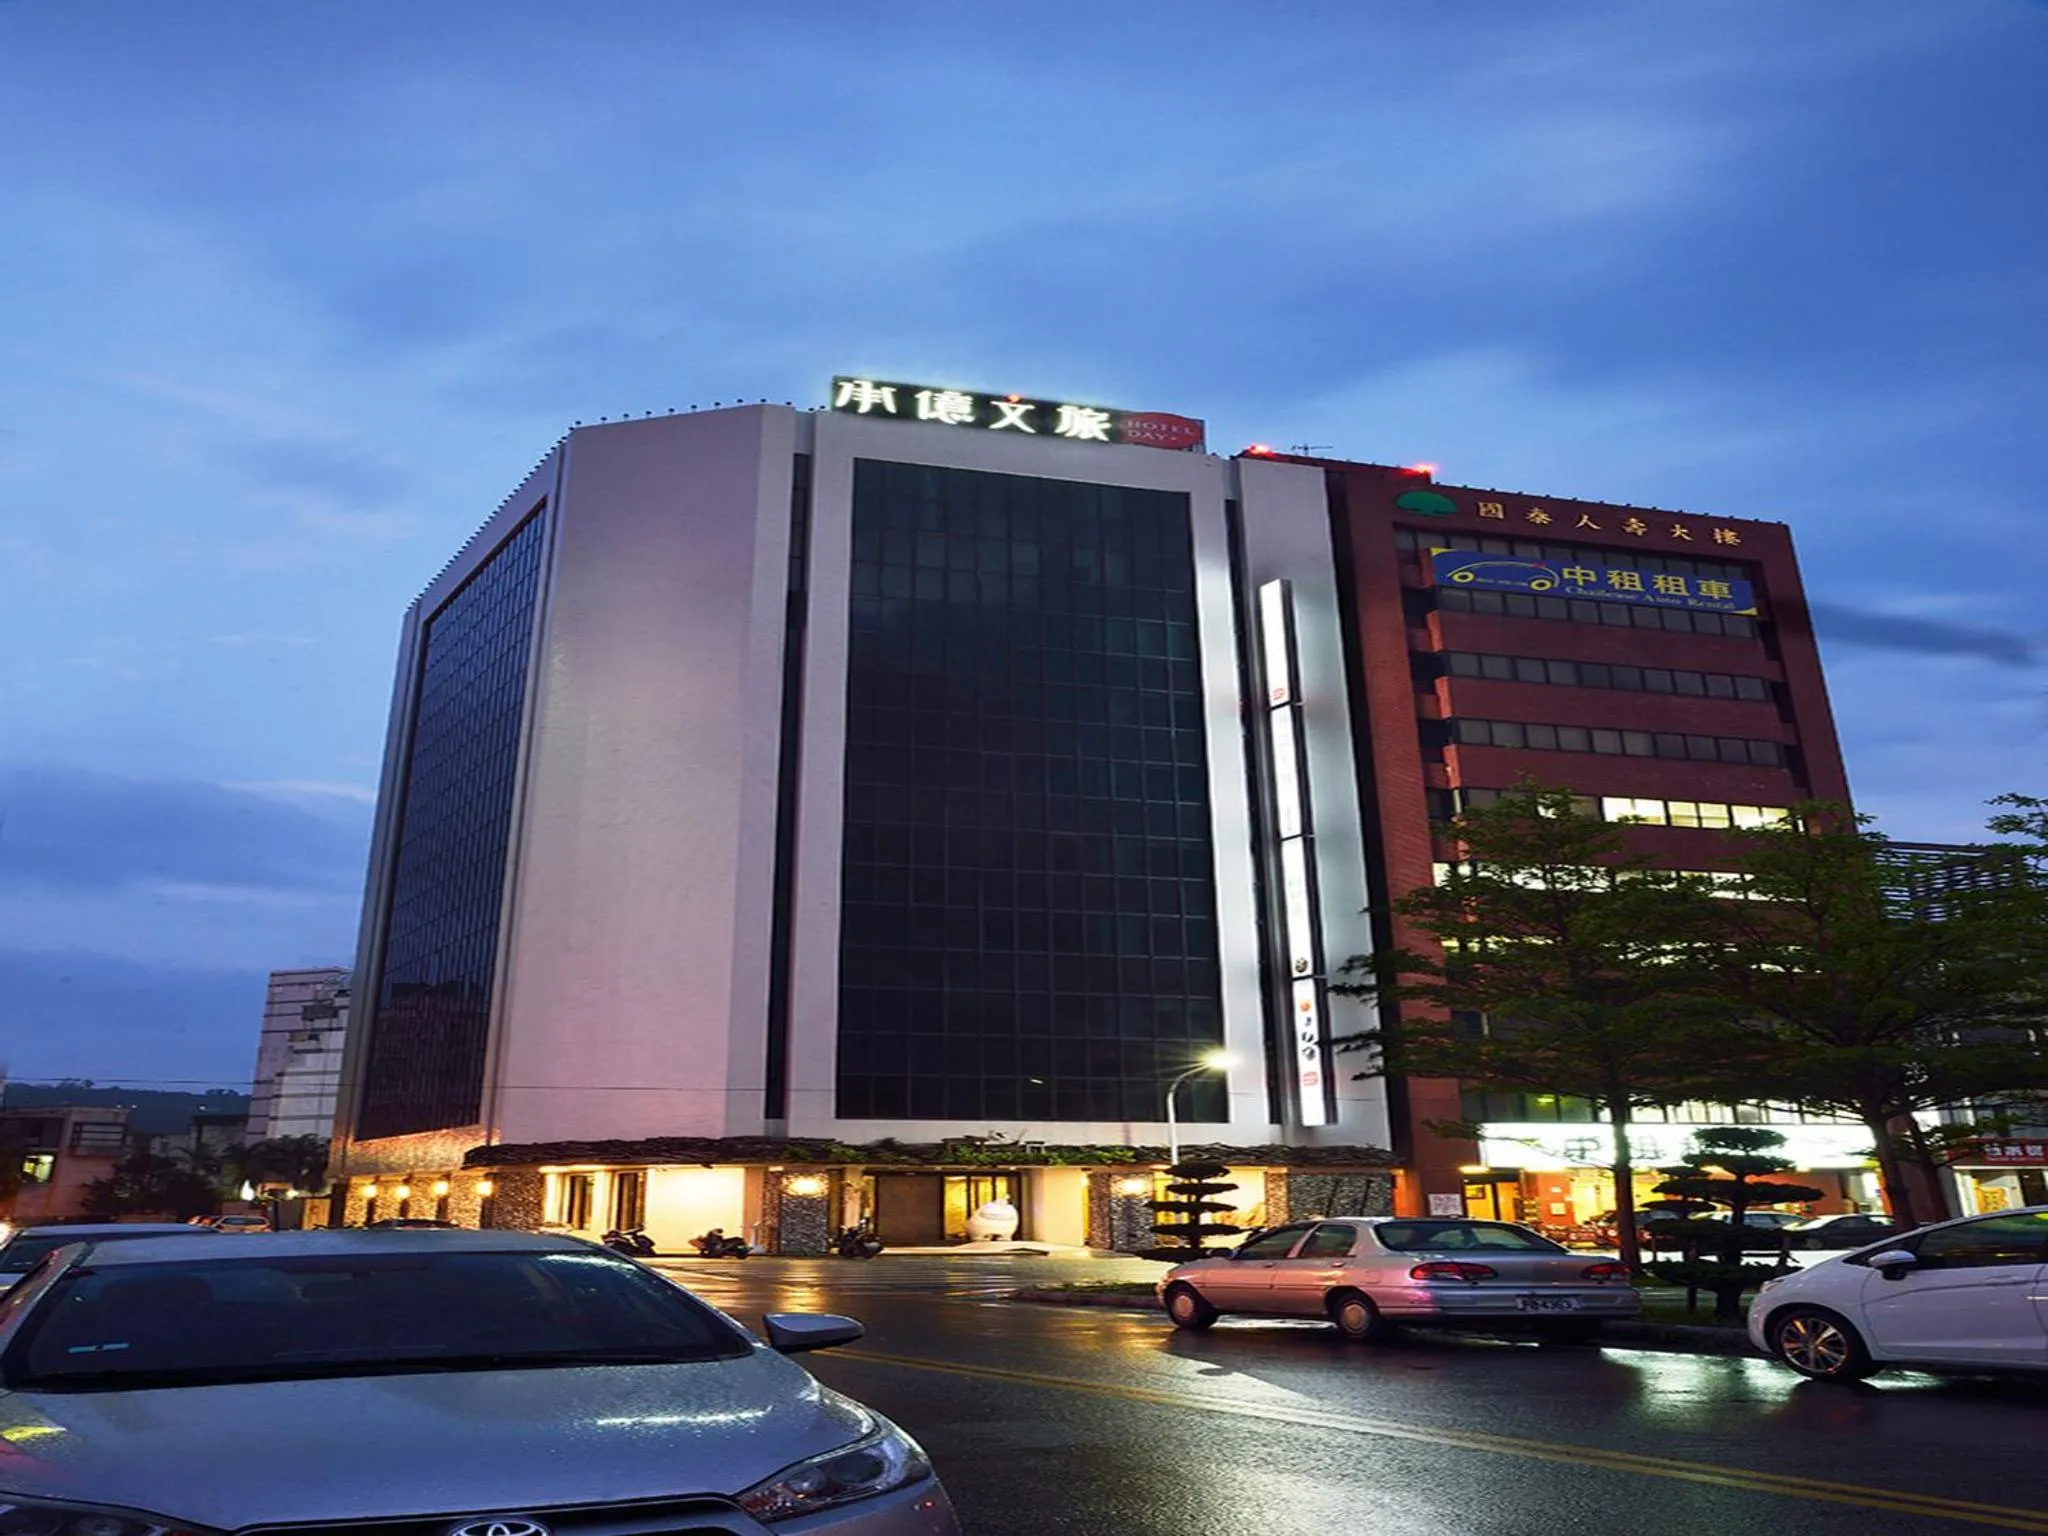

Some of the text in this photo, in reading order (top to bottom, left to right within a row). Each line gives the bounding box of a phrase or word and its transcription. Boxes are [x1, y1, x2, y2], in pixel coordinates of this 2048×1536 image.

[834, 380, 1113, 442] 承億文旅
[1127, 420, 1197, 437] HOTEL
[1478, 501, 1742, 547] 國泰人壽大樓
[1562, 565, 1733, 600] 中租租車
